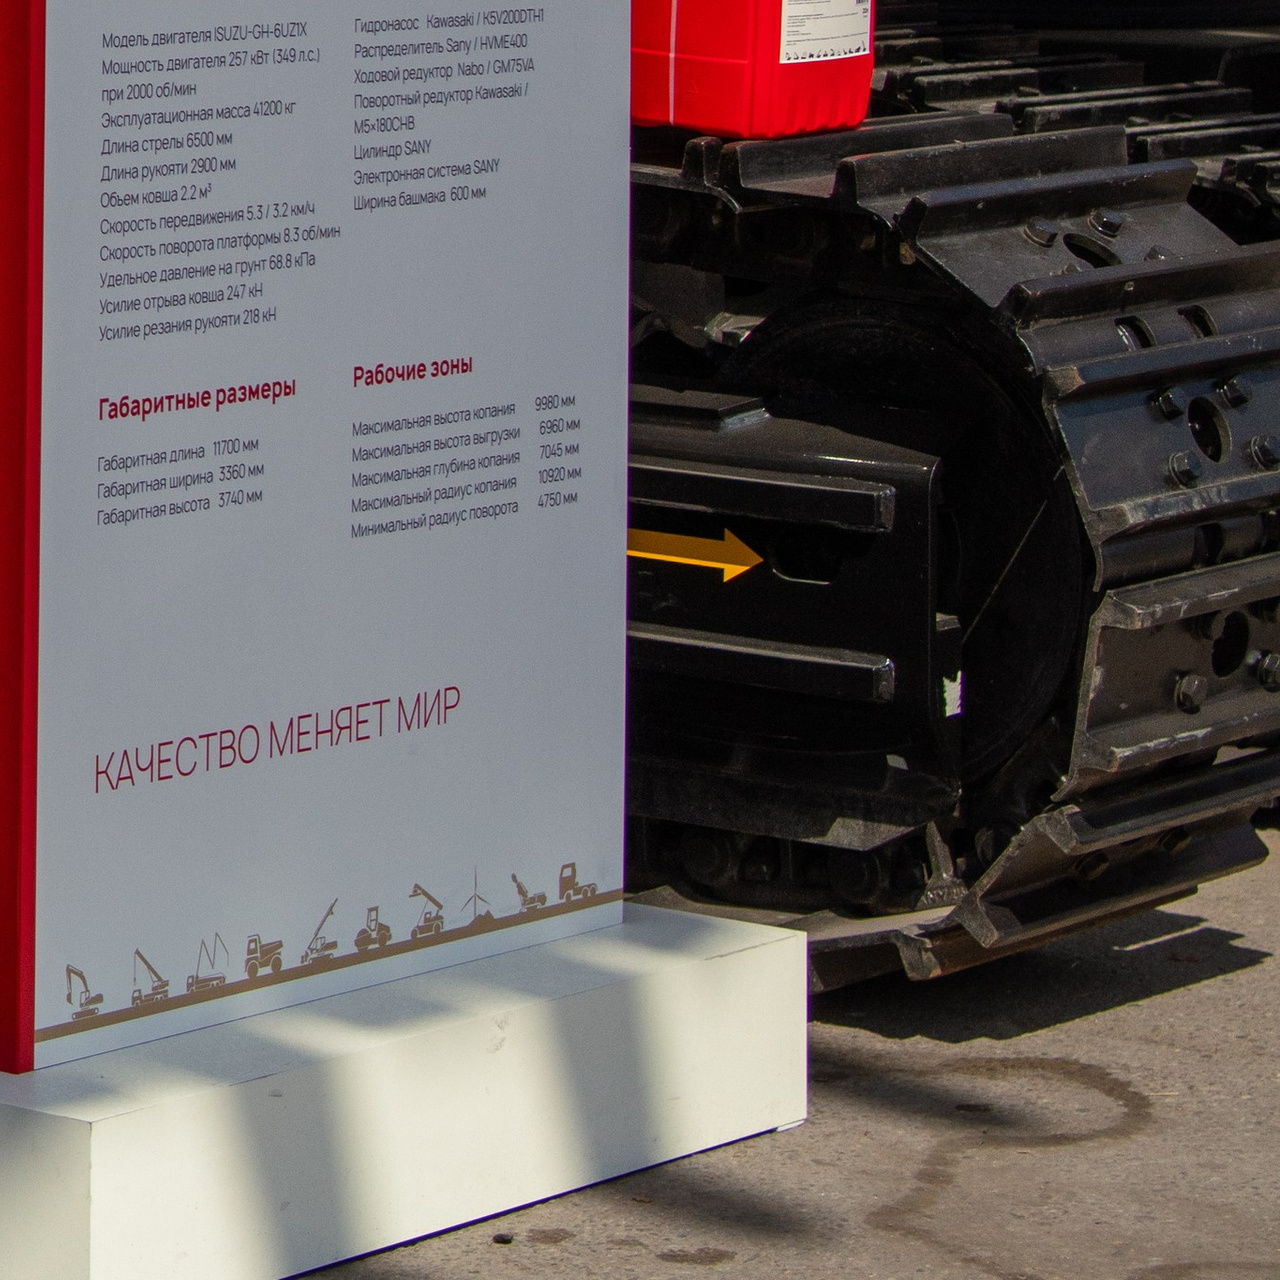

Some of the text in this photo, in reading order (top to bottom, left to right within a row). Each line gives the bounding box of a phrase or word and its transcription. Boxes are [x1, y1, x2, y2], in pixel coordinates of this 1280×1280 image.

[102, 32, 150, 49] Модель
[150, 30, 212, 47] двигателя
[354, 17, 420, 36] Гидронасос
[426, 12, 474, 29] Kawasaki
[101, 59, 165, 75] Мощность
[165, 55, 227, 72] двигателя
[228, 50, 249, 67] 257
[250, 49, 270, 66] кВт
[272, 47, 297, 65] (349
[354, 41, 445, 61] Распределитель
[445, 37, 472, 56] Sany
[353, 66, 401, 84] Ходовой
[402, 65, 453, 85] редуктор
[457, 61, 485, 77] Nabo
[101, 81, 197, 106] при 2000 об/мин
[354, 83, 523, 112] Поворотный редуктор Kawasaki
[101, 99, 297, 130] Эксплуатационная масса 41200 кг
[100, 130, 233, 157] Длина стрелы 6500 мм
[353, 138, 432, 161] Цилиндр SANY
[100, 156, 237, 183] Длина рукояти 2900 мм
[353, 158, 501, 186] Электронная система SANY
[100, 191, 140, 209] Объем
[141, 189, 179, 205] ковша
[180, 184, 197, 201] 2.2
[353, 185, 487, 214] Ширина башмака 600 мм
[99, 200, 315, 238] Скорость передвижения 5.3 3.2 км/ч
[99, 224, 341, 264] Скорость поворота платформы 8.3 об/мин
[99, 251, 316, 289] Удельное давление на грунт 68.8 кПа
[99, 282, 263, 315] Усилие отрыва ковша 247 кН
[98, 306, 277, 342] Усилие резания рукояти 218 кН
[353, 356, 473, 388] Рабочие зоны
[99, 379, 296, 422] Габаритные размеры
[352, 394, 576, 437] Максимальная высота копания 9980 мм
[97, 437, 259, 473] Габаритная длина 11700 мм
[351, 417, 581, 462] Максимальная высота выгрузки 6960 мм
[97, 462, 265, 500] Габаритная ширина 3360 мм
[351, 442, 580, 488] Максимальная глубина копания 7045 мм
[351, 466, 582, 513] Максимальный радиус копания 10920 мм
[97, 489, 263, 526] Габаритная высота 3740 мм
[351, 491, 578, 539] Минимальный радиус поворота 4750 мм
[95, 685, 461, 794] КАЧЕСТВО МЕНЯЕТ МИР
